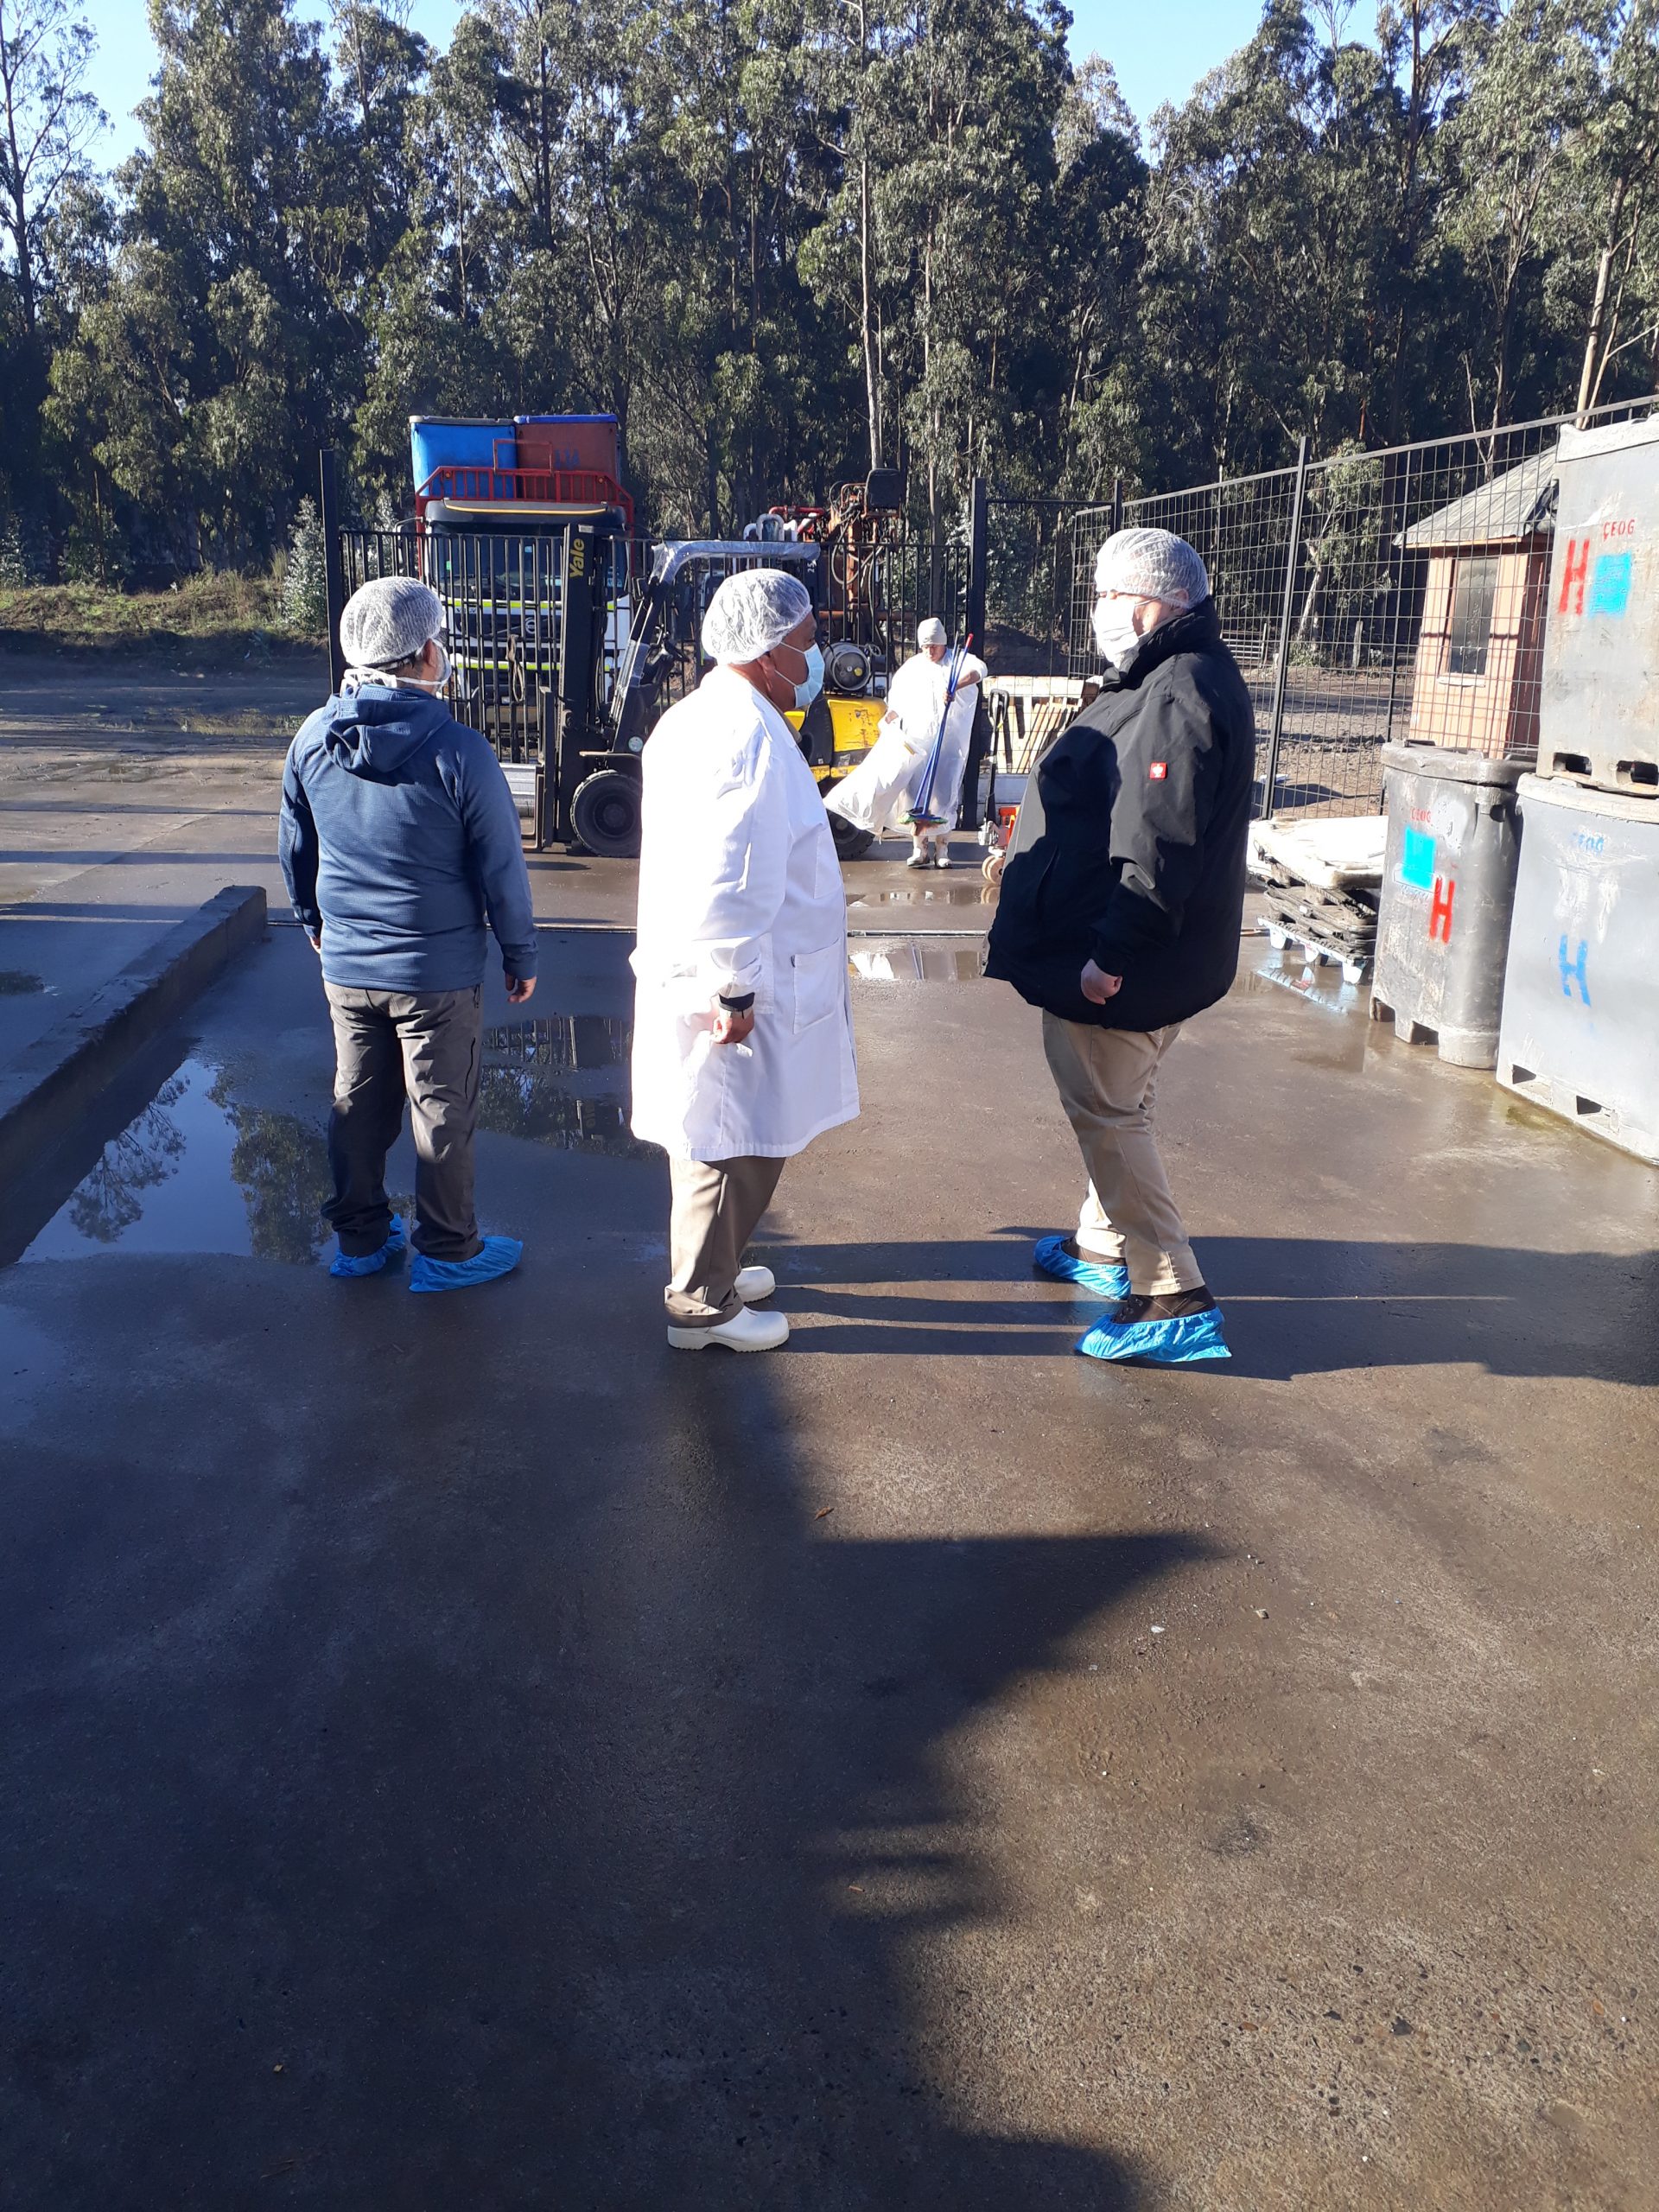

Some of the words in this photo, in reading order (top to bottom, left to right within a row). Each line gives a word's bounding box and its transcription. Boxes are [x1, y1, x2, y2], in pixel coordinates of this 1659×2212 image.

[569, 538, 585, 577] Yale
[1559, 539, 1590, 616] H
[1429, 877, 1455, 944] H
[1560, 934, 1591, 1007] H
